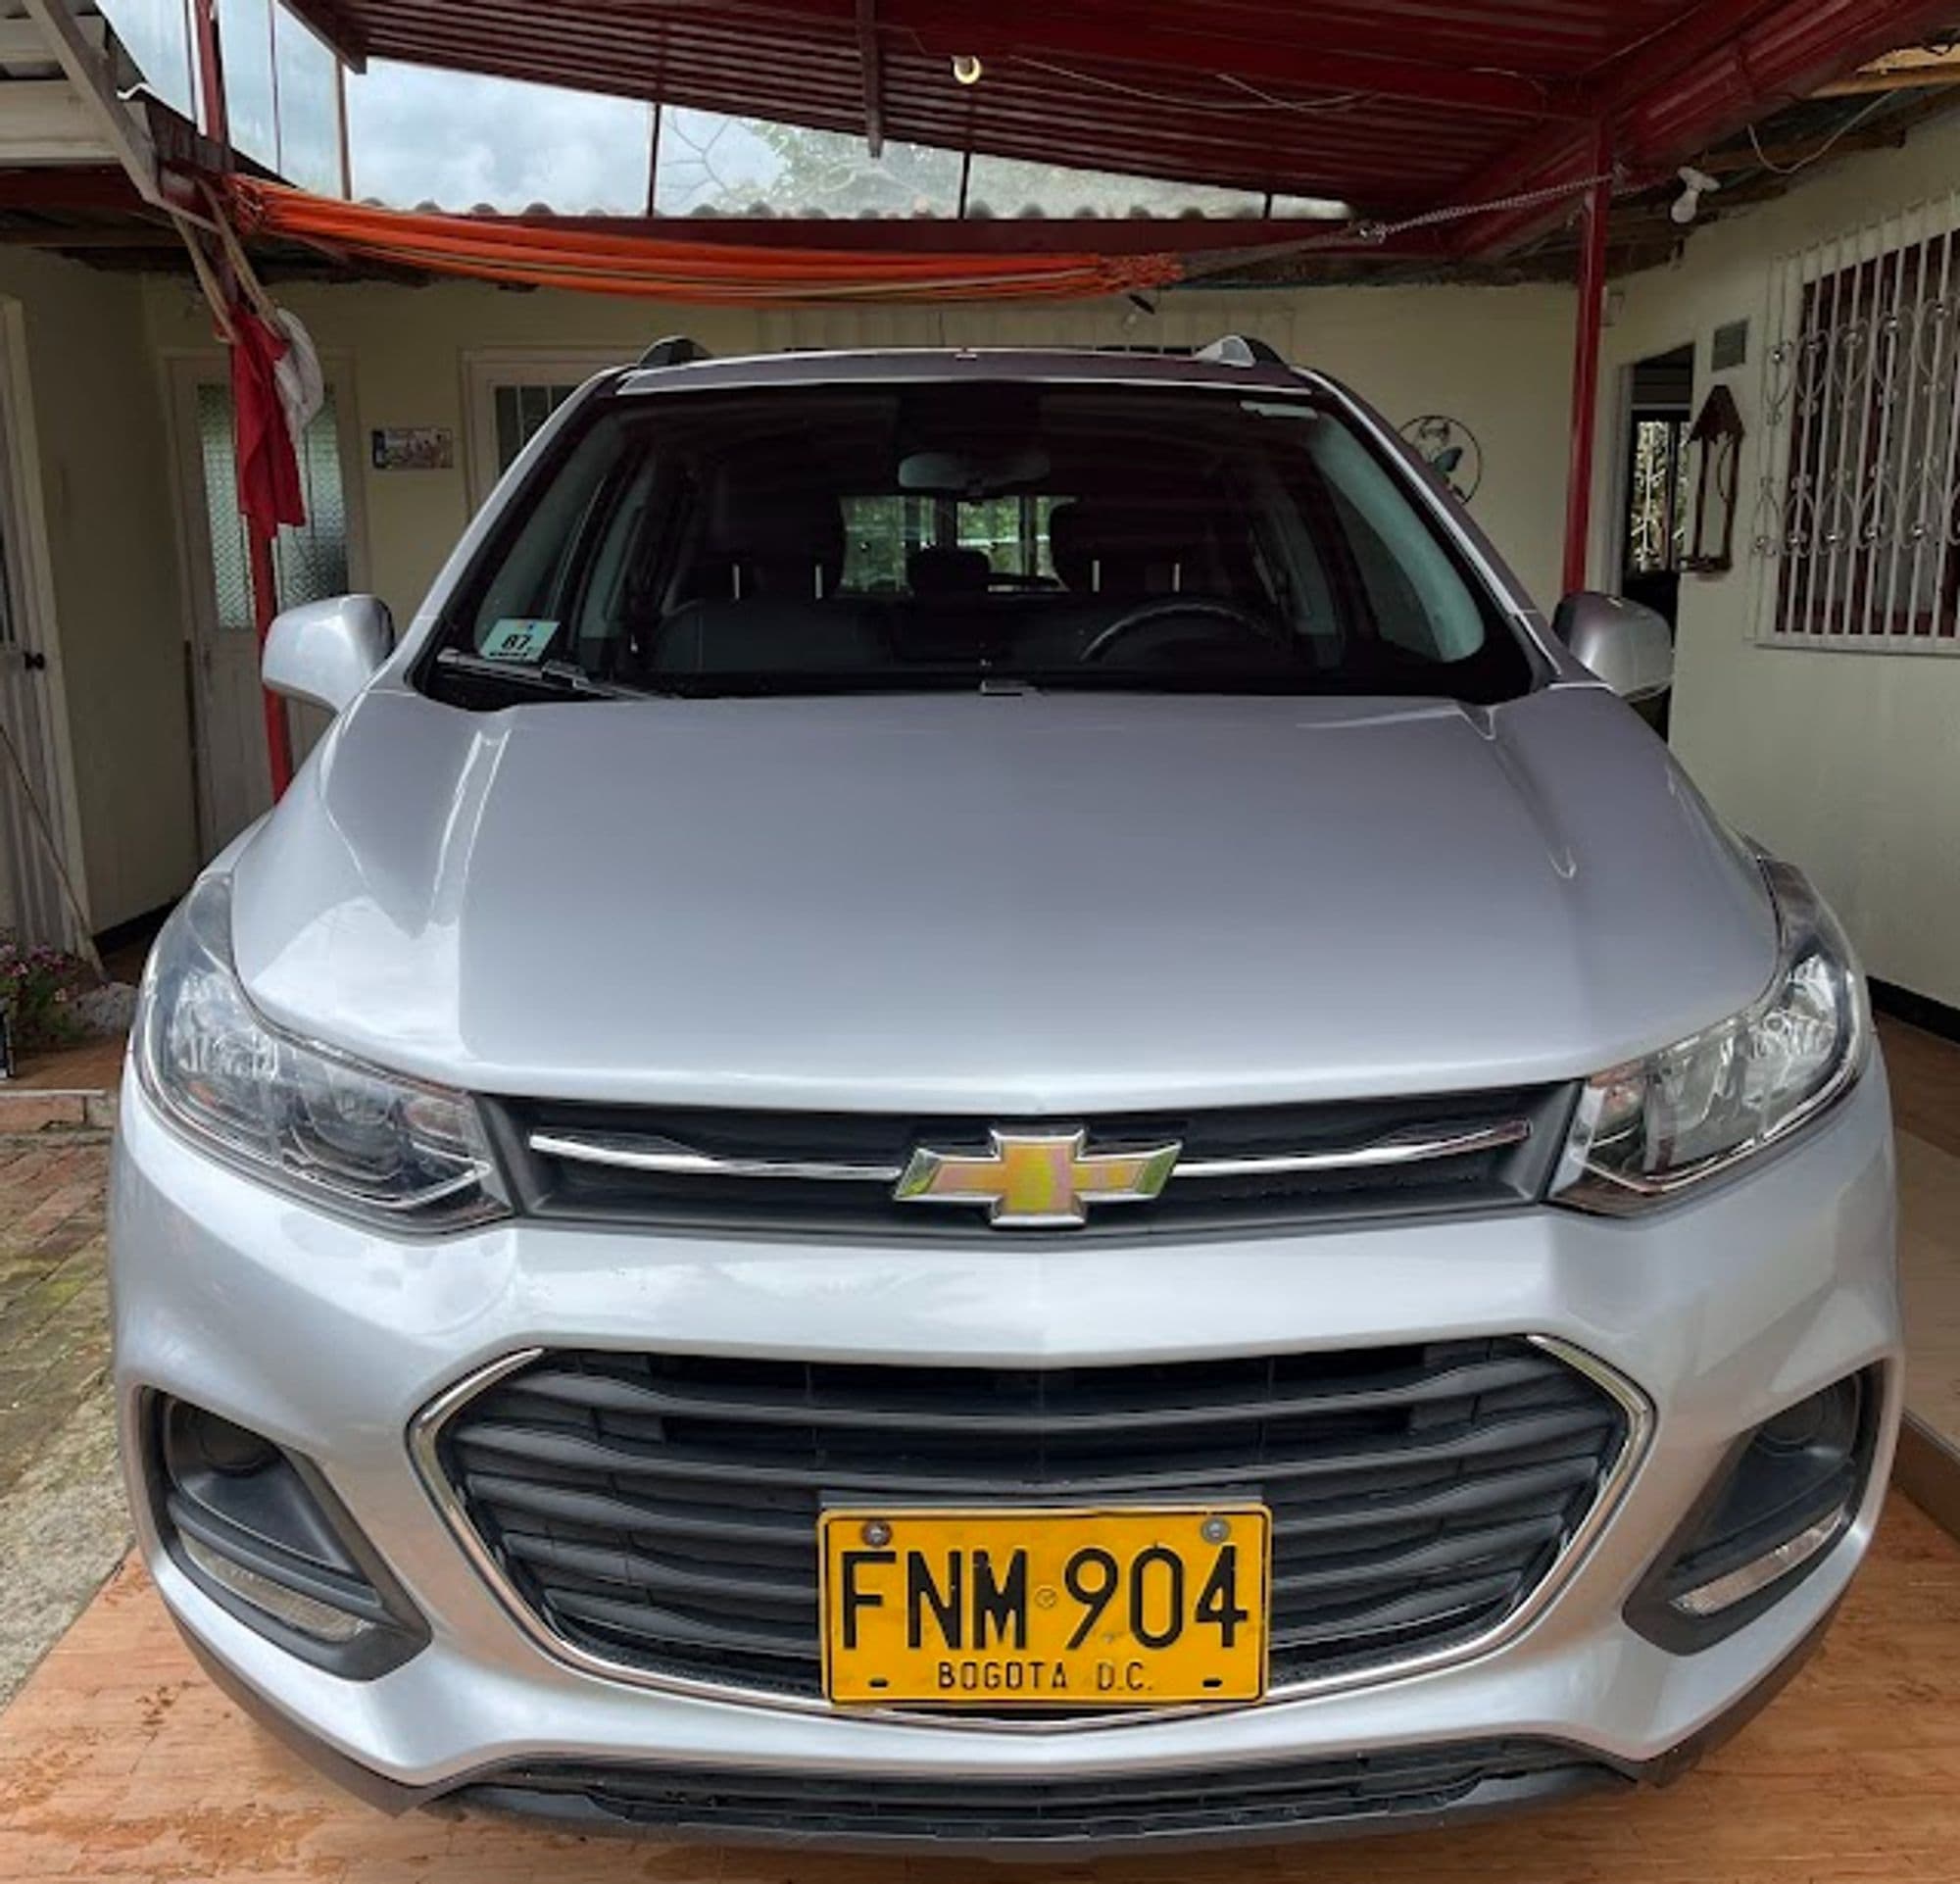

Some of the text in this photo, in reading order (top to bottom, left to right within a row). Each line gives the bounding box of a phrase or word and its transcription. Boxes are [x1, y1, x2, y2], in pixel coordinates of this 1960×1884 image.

[842, 1546, 1248, 1650] FNM 904
[938, 1661, 1153, 1691] BOGOTA D.C.
